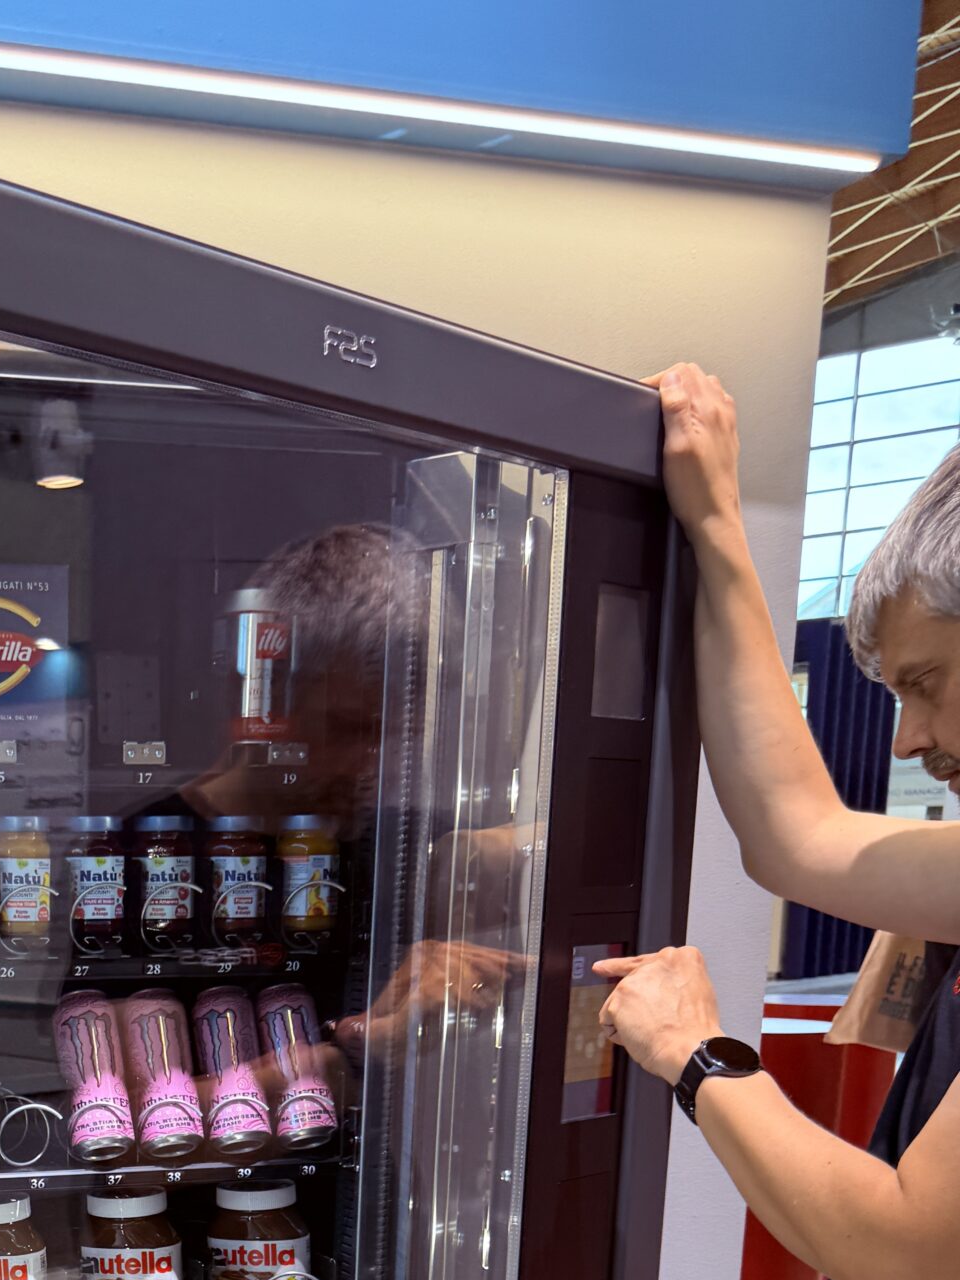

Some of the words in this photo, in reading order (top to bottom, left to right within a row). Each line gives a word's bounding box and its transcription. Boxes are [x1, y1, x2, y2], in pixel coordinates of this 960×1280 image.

[258, 627, 288, 656] illy
[138, 772, 153, 785] 17
[282, 773, 297, 785] 19
[74, 966, 89, 977] 27
[146, 964, 161, 975] 28
[217, 963, 232, 973] 29
[285, 961, 300, 971] 20
[0, 966, 15, 978] 26
[237, 1168, 252, 1178] 39
[301, 1165, 316, 1176] 30
[107, 1174, 122, 1185] 37
[167, 1172, 182, 1182] 38
[30, 1178, 46, 1189] 36
